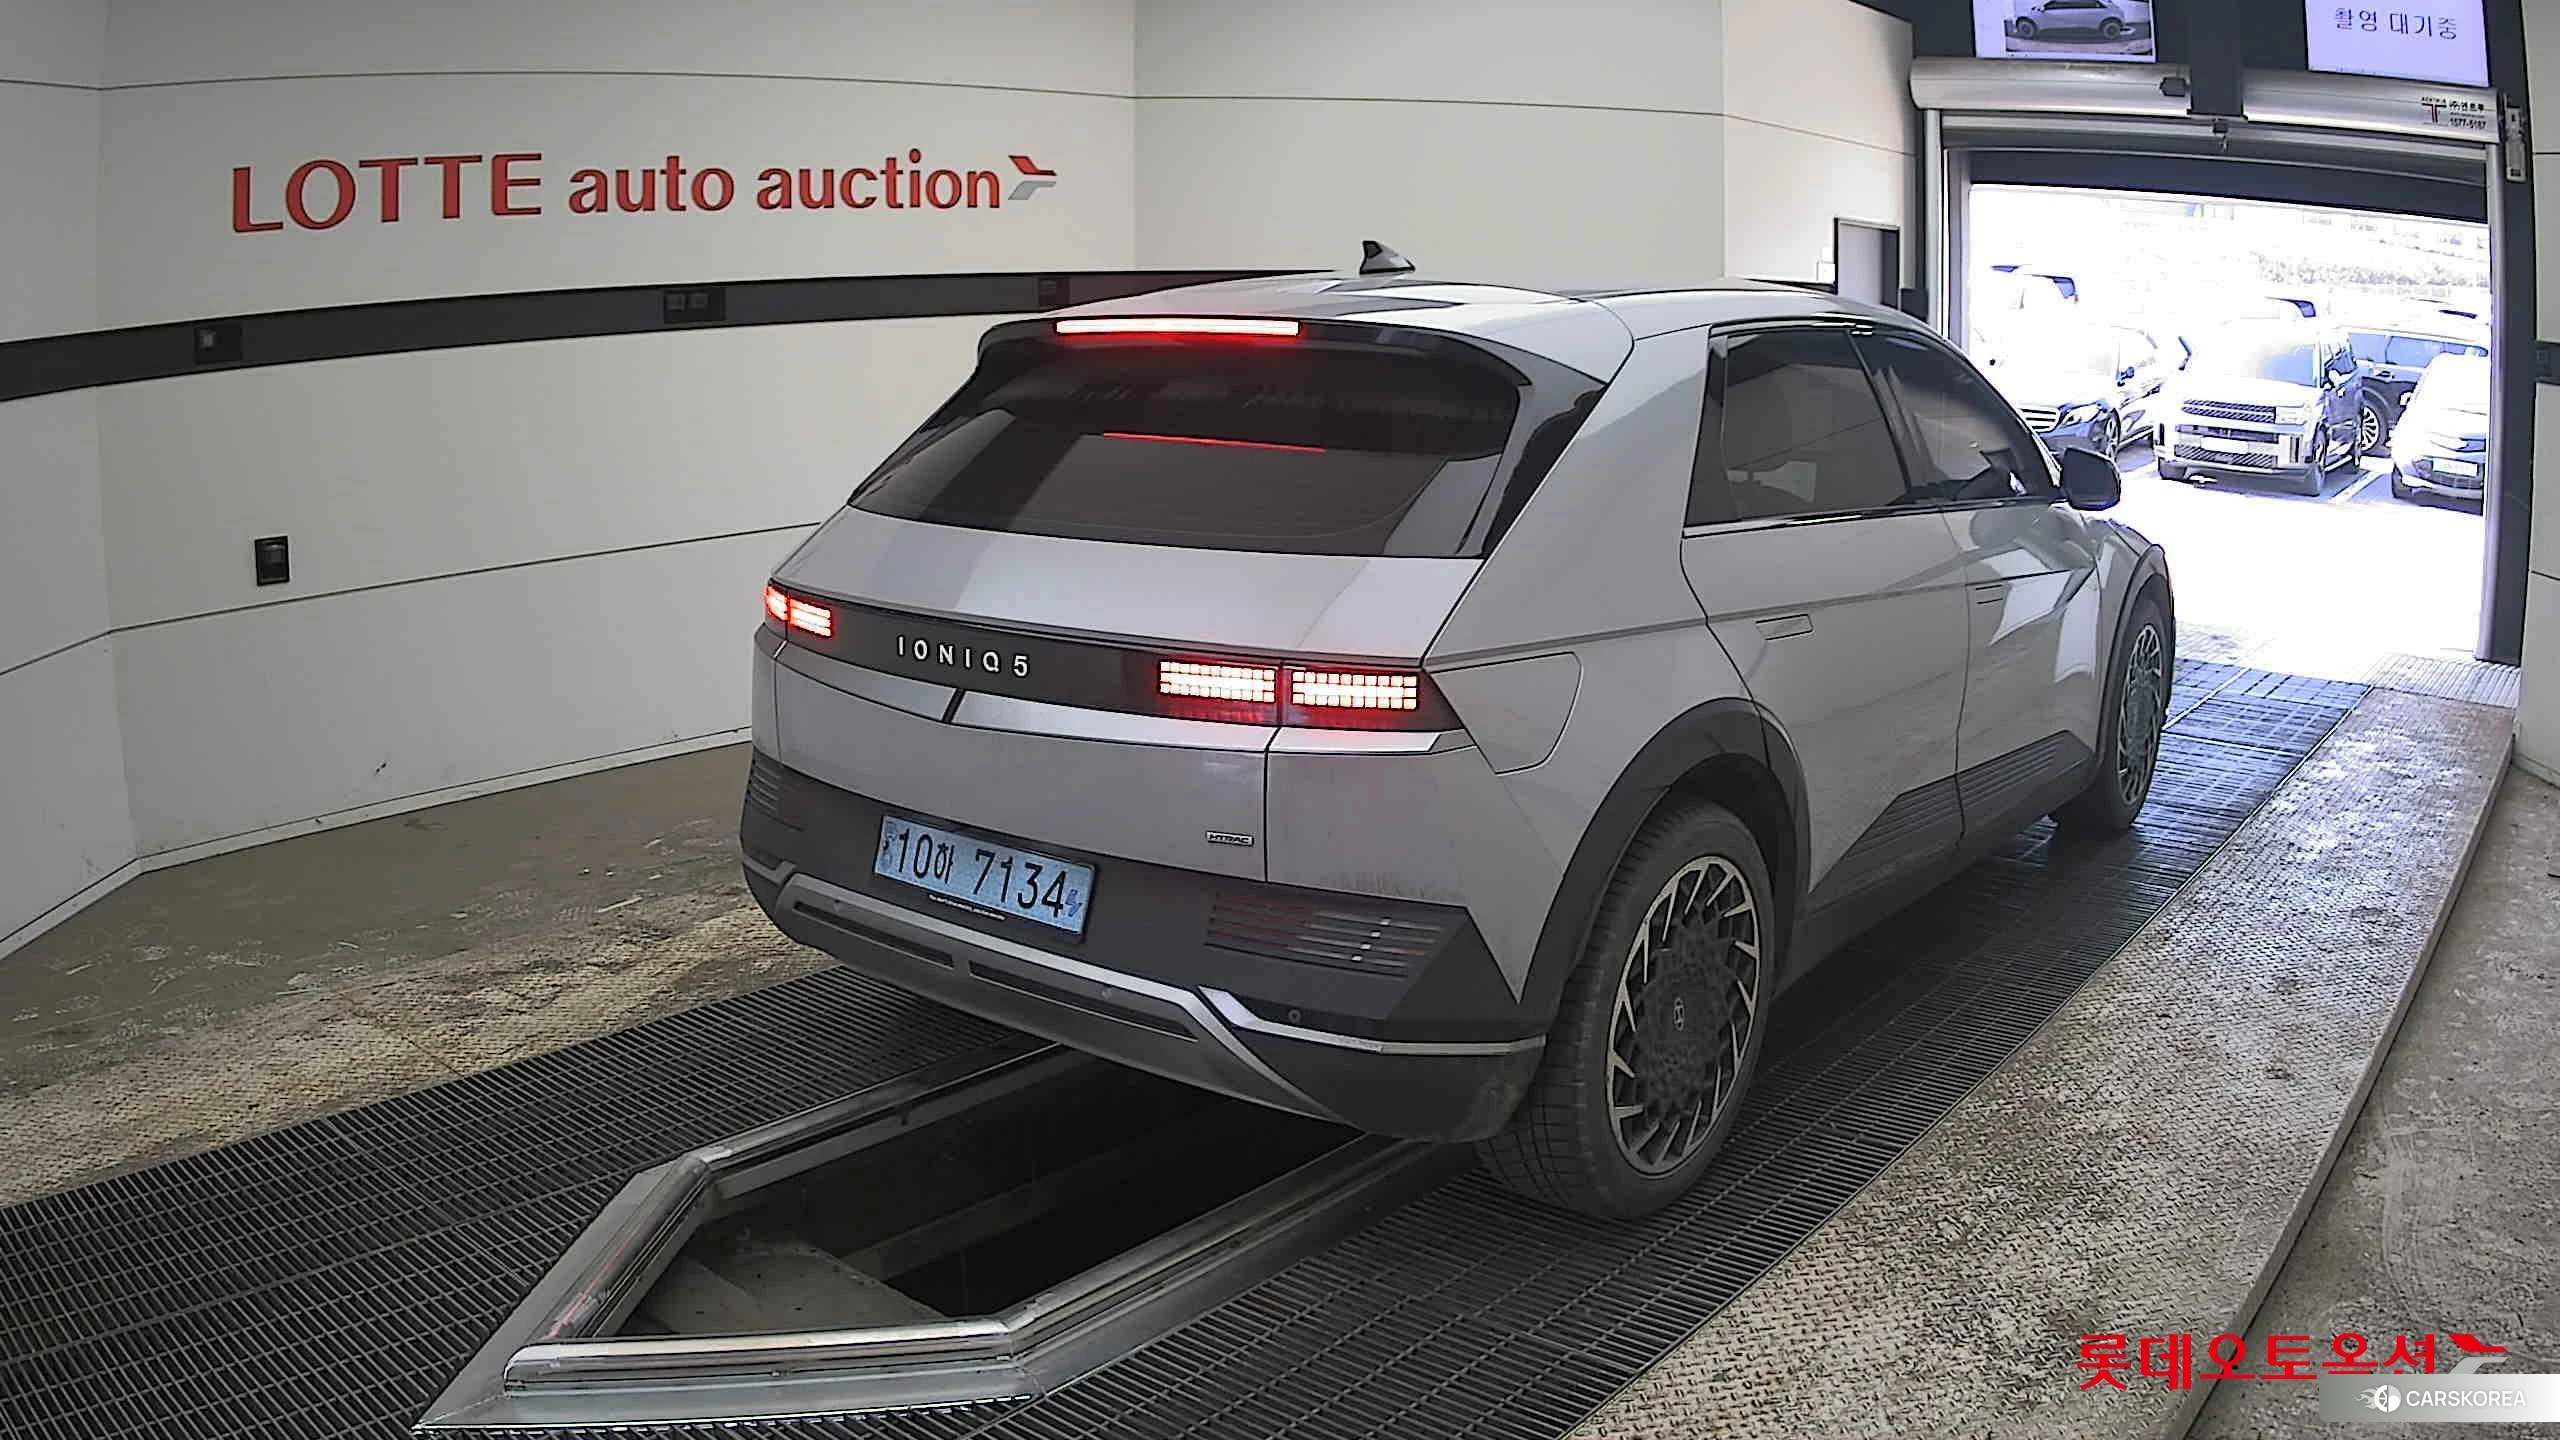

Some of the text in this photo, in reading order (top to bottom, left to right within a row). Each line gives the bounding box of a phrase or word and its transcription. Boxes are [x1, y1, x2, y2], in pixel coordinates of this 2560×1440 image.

[2335, 8, 2457, 40] 촬영 대기중
[232, 147, 1001, 234] LOTTE auto auction
[897, 635, 1029, 677] IONIQ 5
[899, 828, 955, 885] 10하
[975, 848, 1065, 918] 7134
